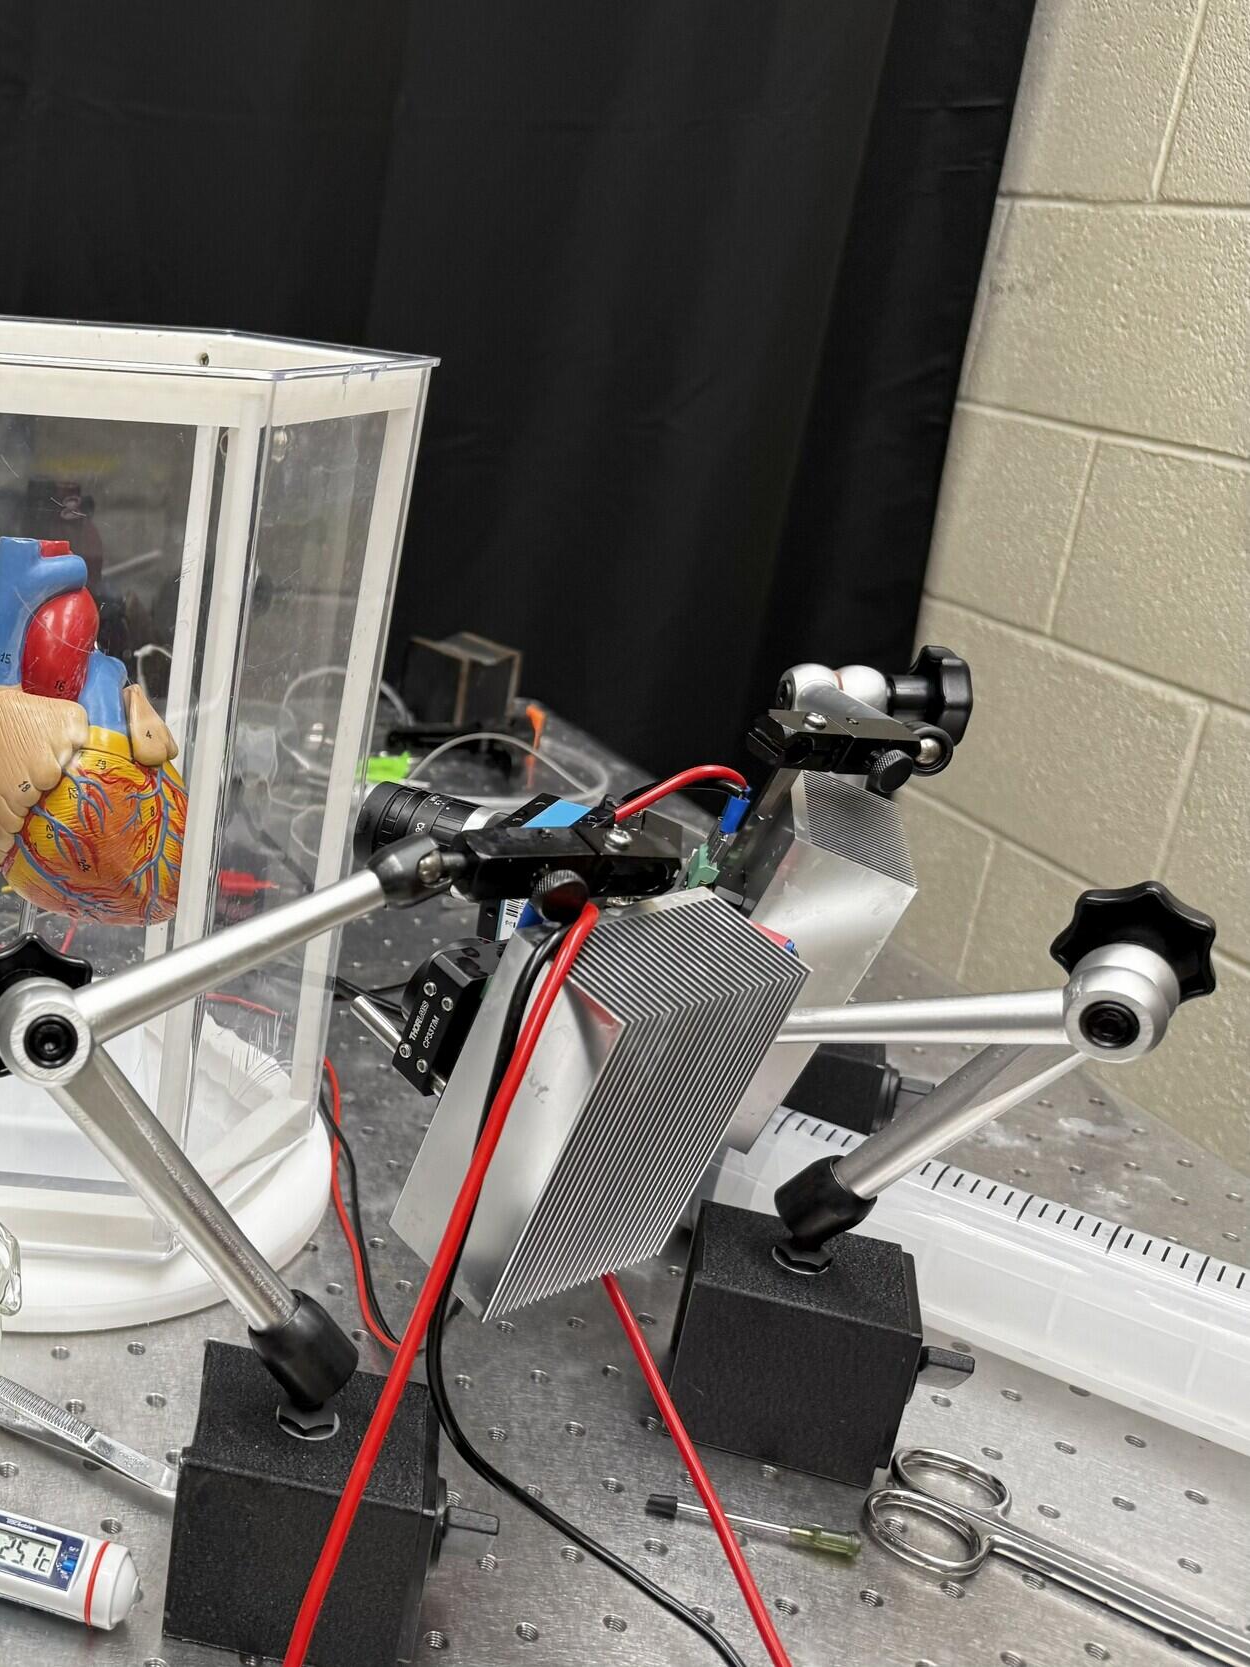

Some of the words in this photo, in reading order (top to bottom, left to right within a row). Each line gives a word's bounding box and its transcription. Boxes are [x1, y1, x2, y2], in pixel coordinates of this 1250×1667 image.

[0, 652, 11, 664] 15
[145, 730, 152, 739] 4
[45, 824, 54, 839] 20
[408, 1000, 430, 1041] THORLABS
